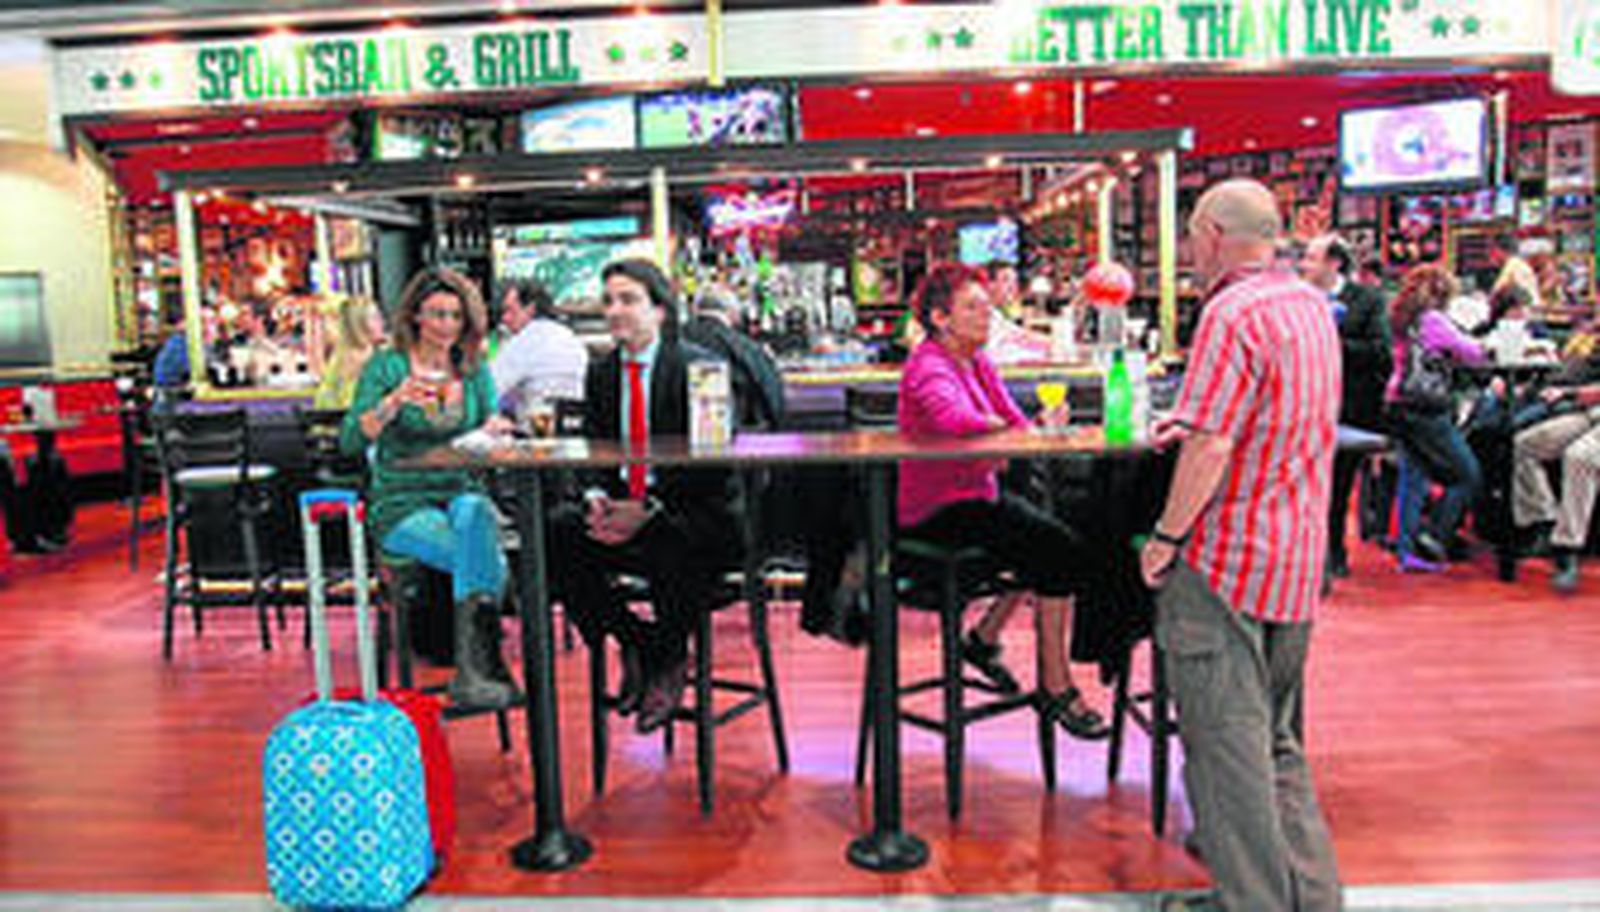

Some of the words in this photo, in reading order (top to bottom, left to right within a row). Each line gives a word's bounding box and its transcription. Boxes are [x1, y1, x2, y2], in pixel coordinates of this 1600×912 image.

[424, 43, 460, 88] &
[473, 28, 580, 87] GRILL
[1177, 0, 1289, 58] THAN
[1301, 0, 1392, 56] LIVE
